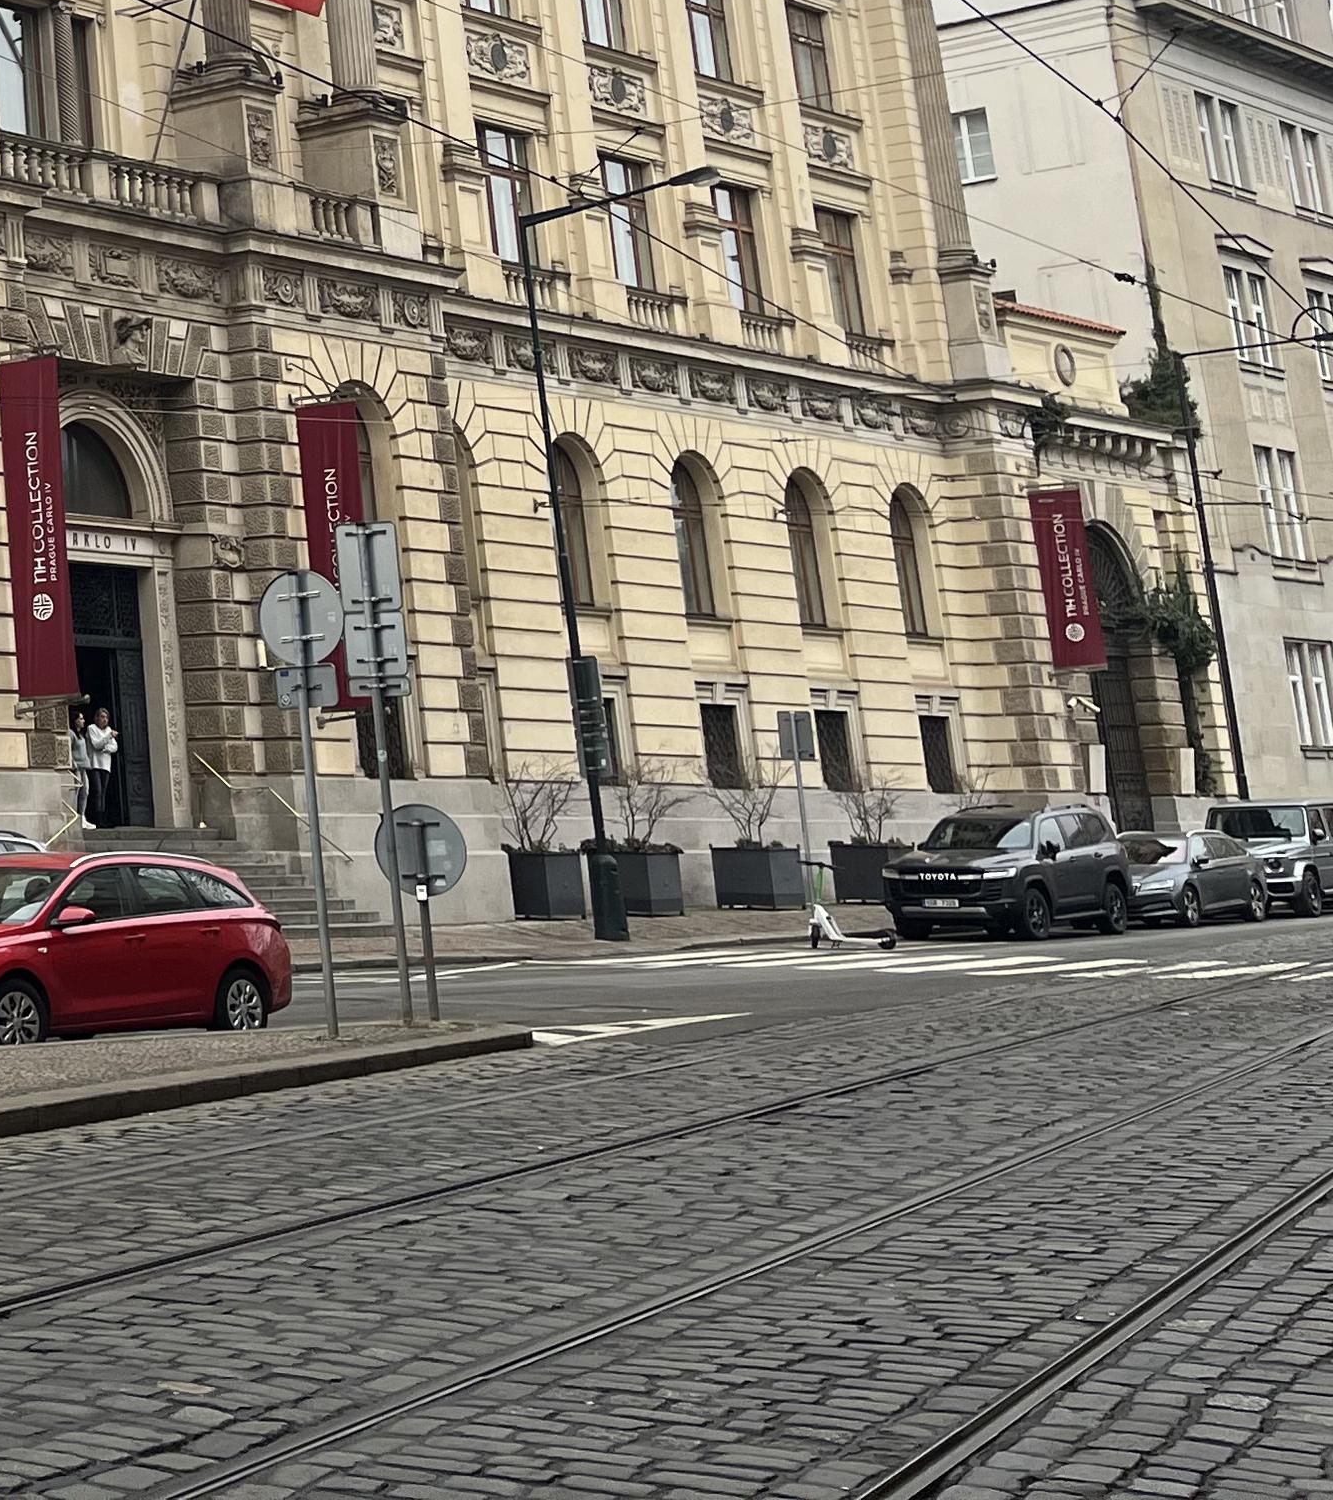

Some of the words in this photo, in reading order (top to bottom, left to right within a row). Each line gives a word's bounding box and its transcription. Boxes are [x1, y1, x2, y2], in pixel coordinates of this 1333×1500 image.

[25, 431, 45, 554] COLLECTION
[44, 482, 52, 494] IV
[45, 495, 55, 534] CARLO
[49, 536, 58, 582] PRAGUE
[73, 531, 111, 550] ARLO
[124, 536, 137, 552] IV
[1051, 513, 1075, 597] COLLECTION
[919, 872, 957, 881] TOYOTA
